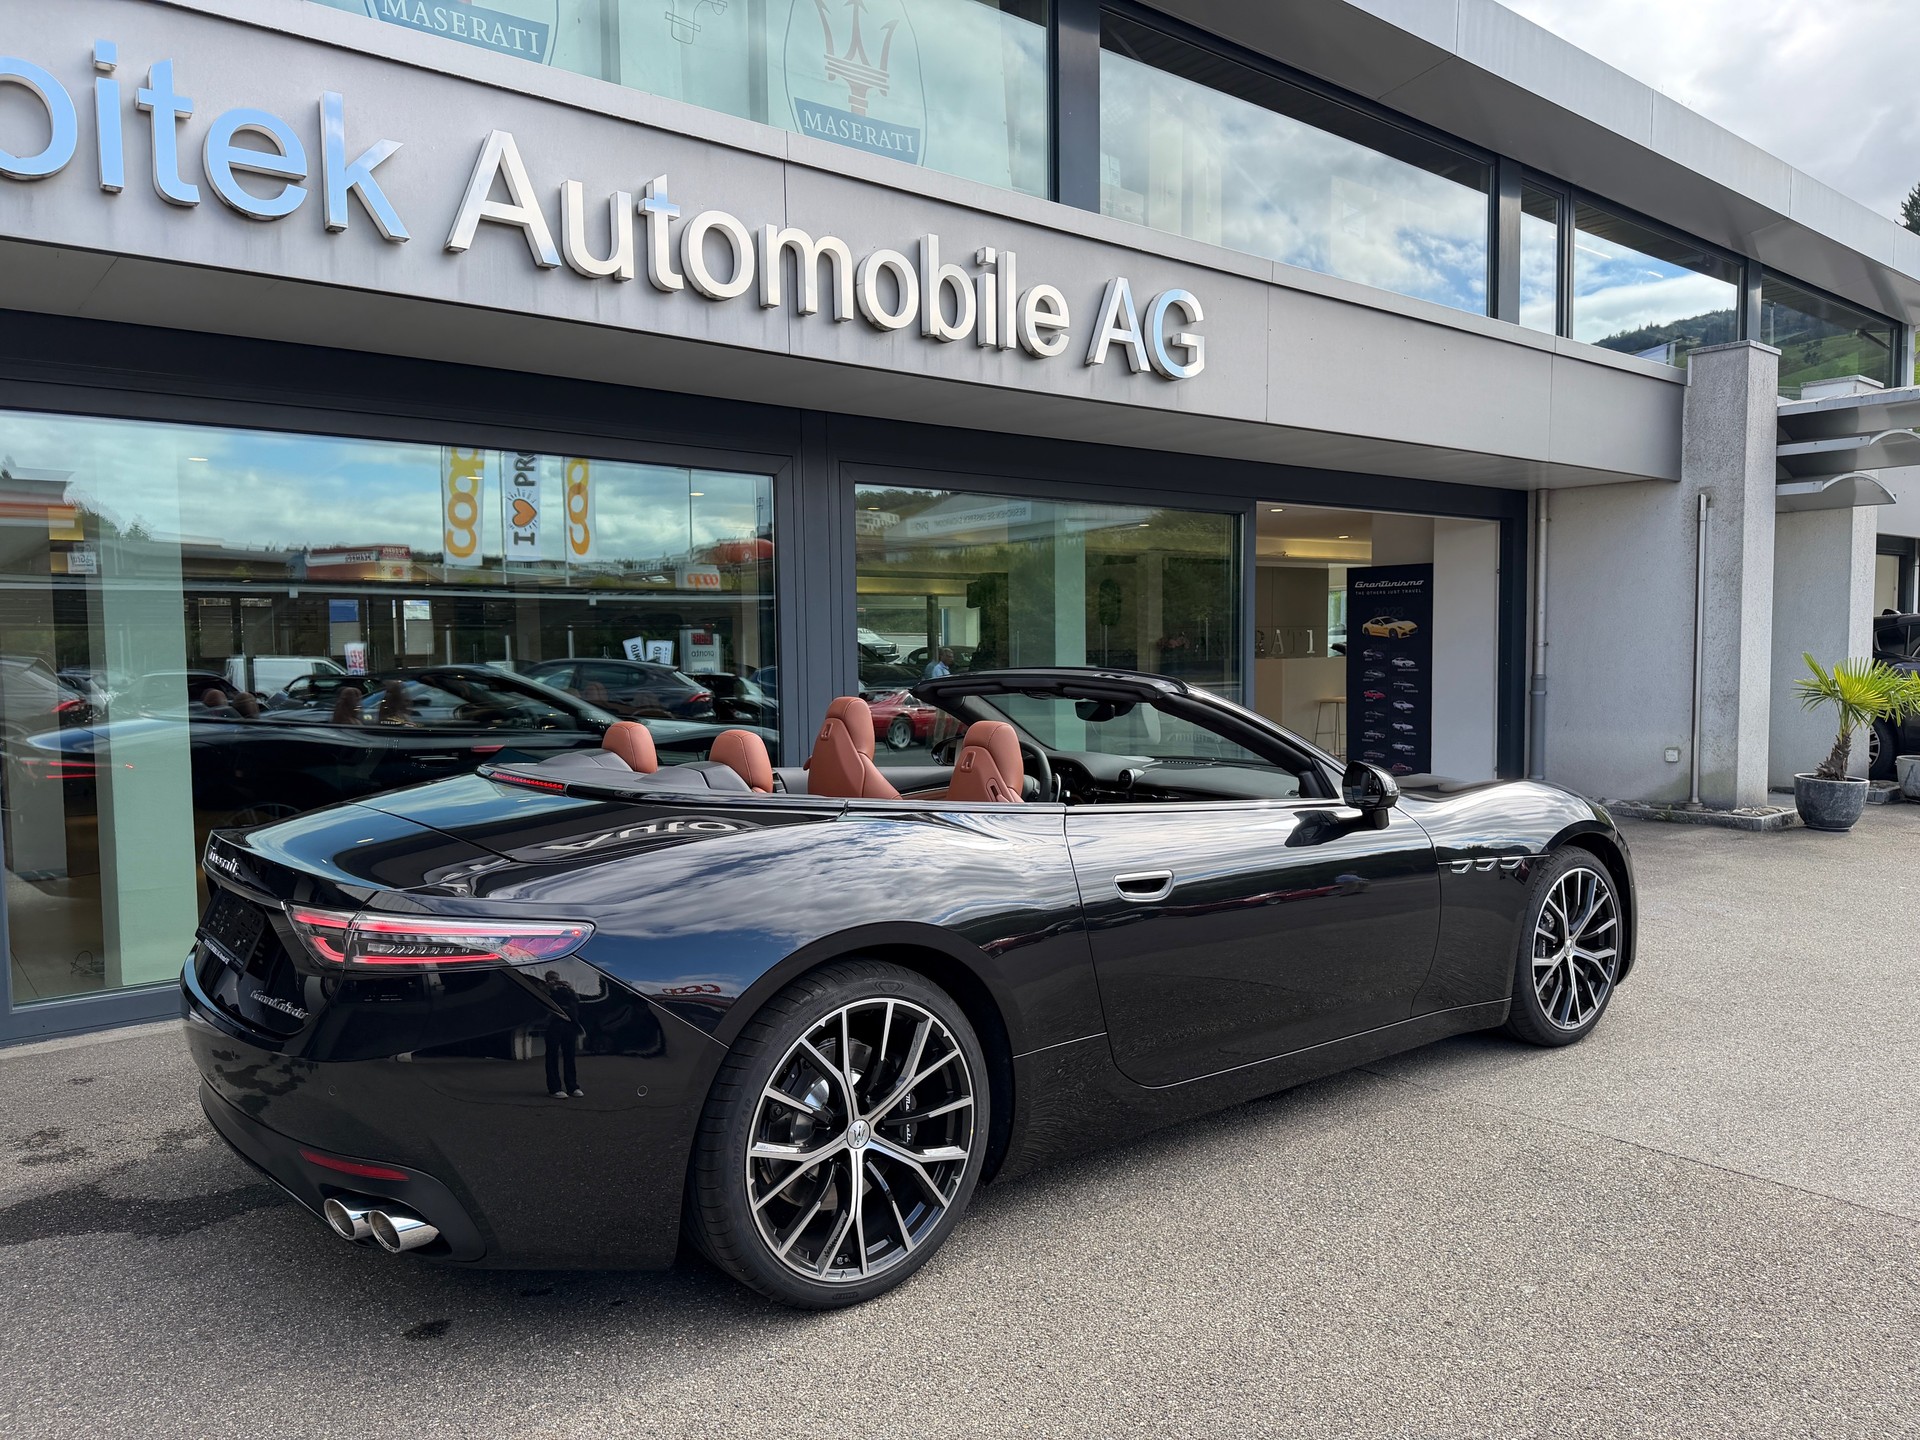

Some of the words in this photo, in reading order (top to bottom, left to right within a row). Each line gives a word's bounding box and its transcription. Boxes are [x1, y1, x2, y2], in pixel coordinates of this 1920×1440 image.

[381, 0, 540, 56] MASERATI
[803, 109, 915, 153] MASERATI
[445, 130, 1071, 359] Automobile
[1084, 277, 1206, 381] AG
[567, 458, 590, 556] coo
[513, 531, 535, 546] I
[1354, 580, 1425, 588] GranTurismo
